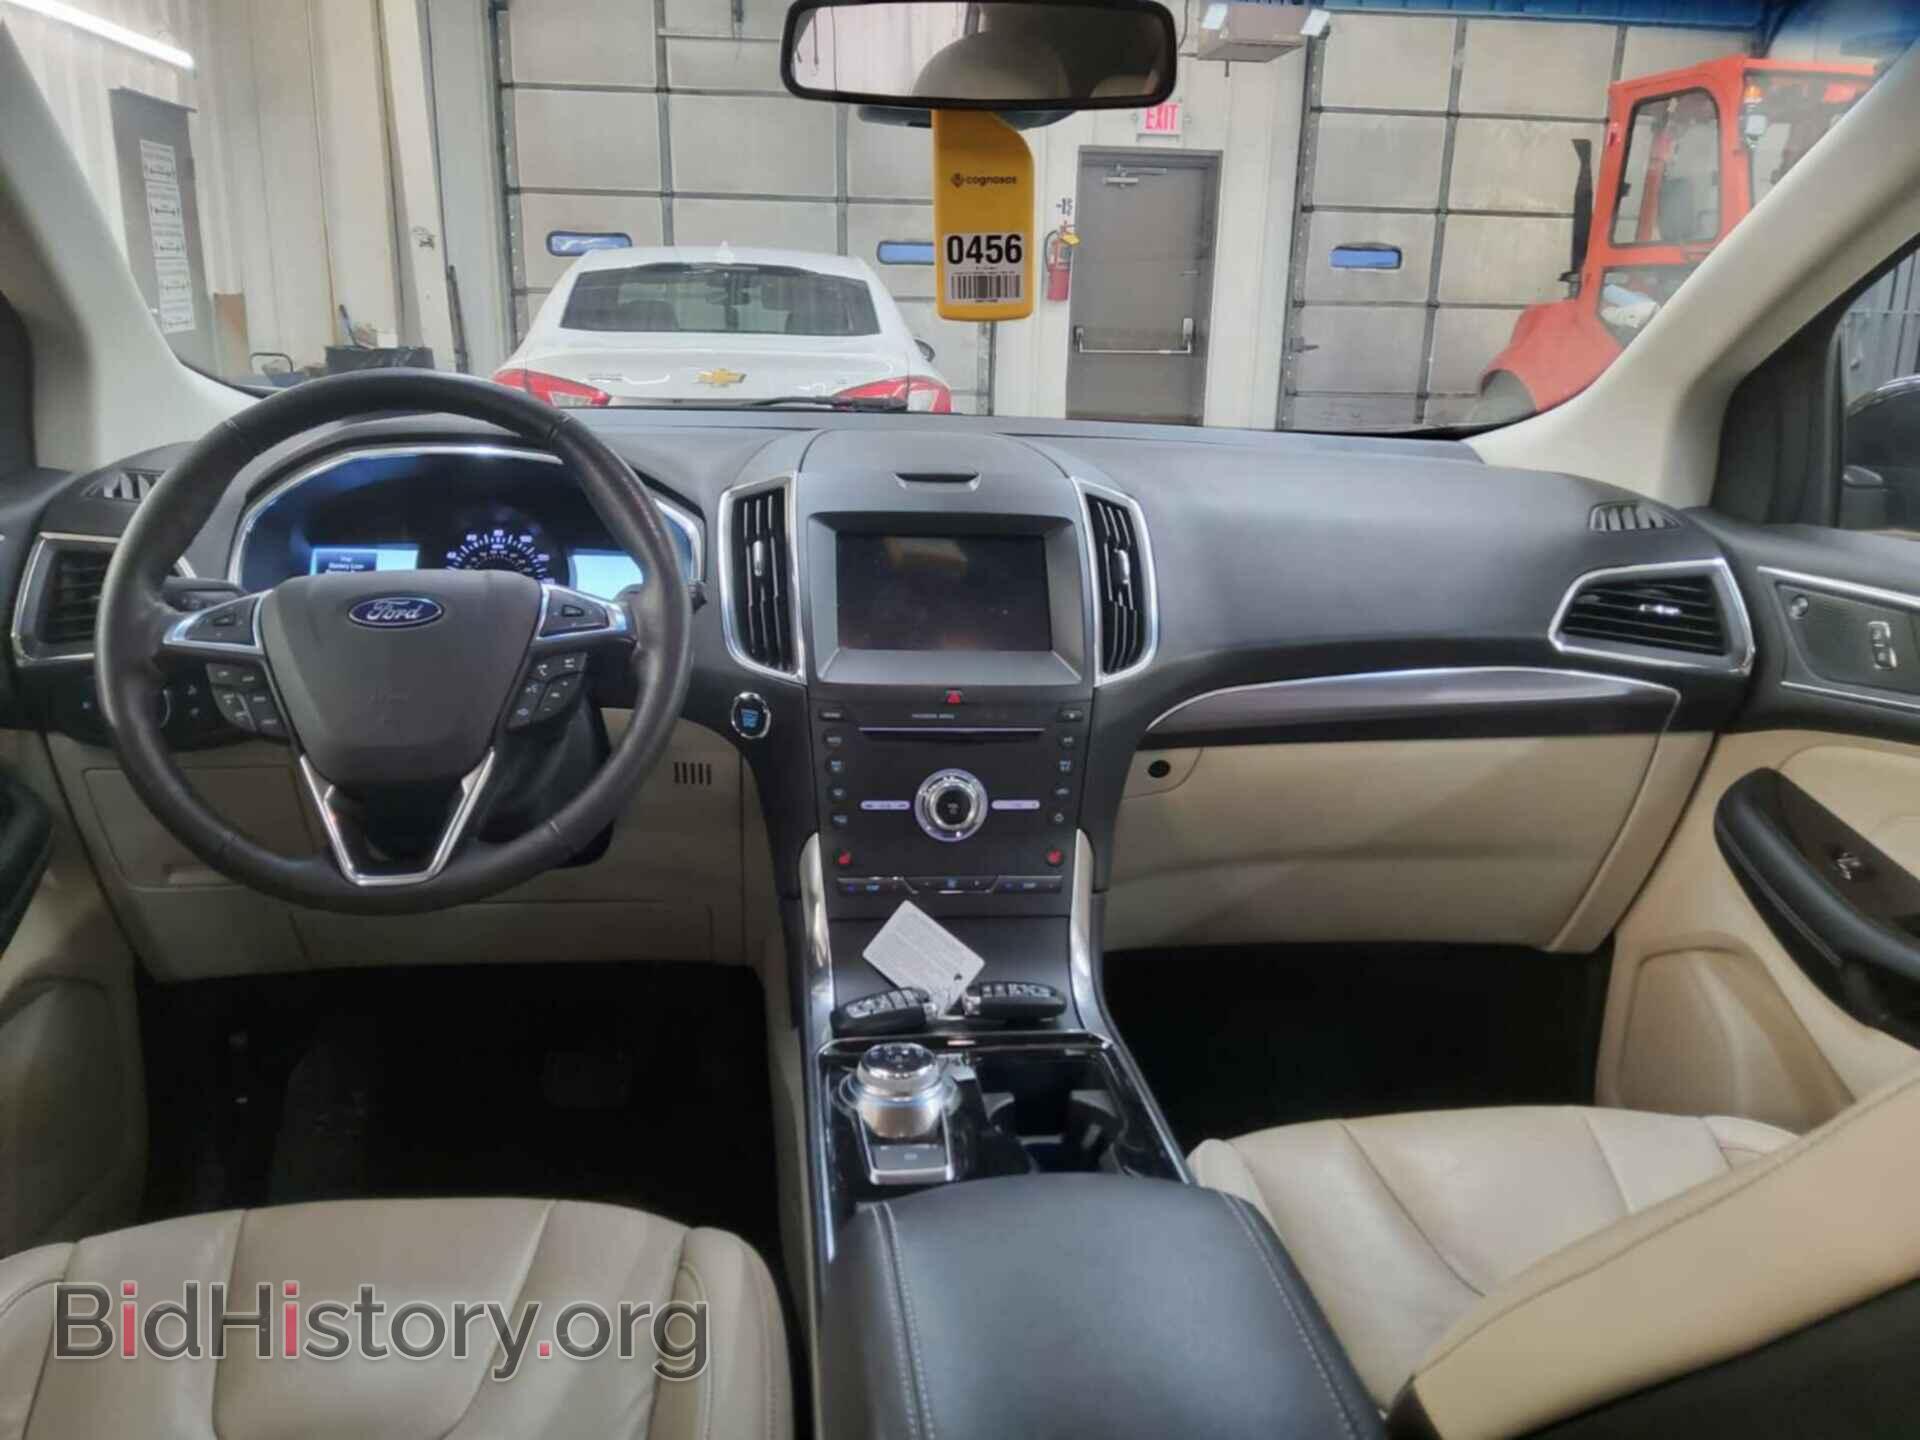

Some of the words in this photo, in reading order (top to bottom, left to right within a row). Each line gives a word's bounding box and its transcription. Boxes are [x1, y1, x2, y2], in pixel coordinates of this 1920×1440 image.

[1144, 103, 1179, 130] EXIT
[946, 234, 1023, 265] 0456
[367, 600, 424, 621] Ford
